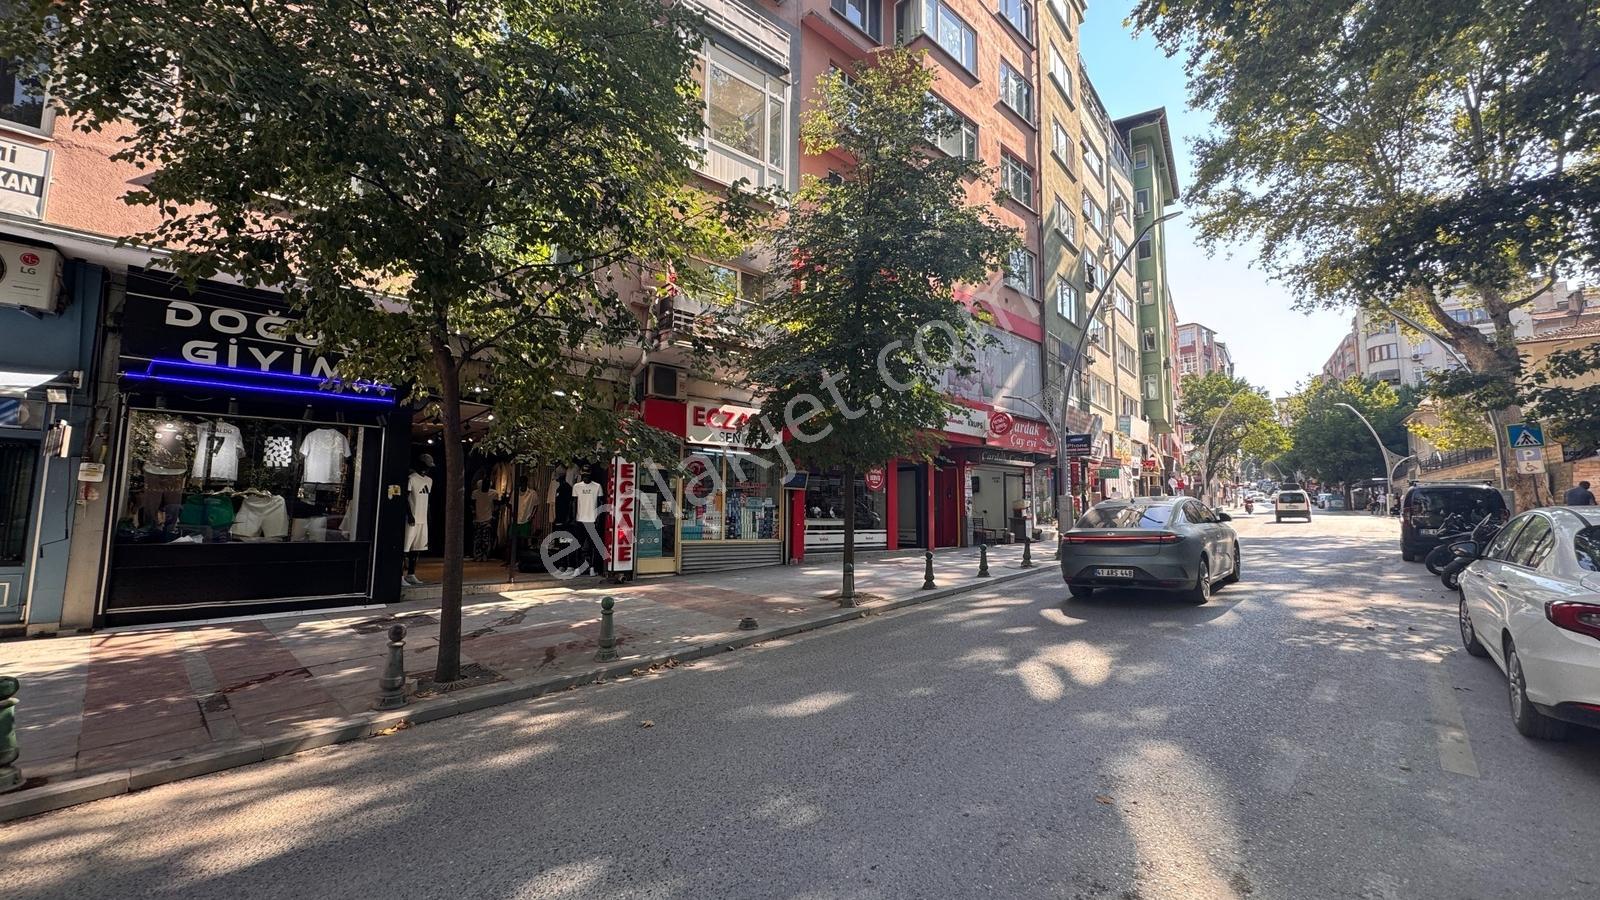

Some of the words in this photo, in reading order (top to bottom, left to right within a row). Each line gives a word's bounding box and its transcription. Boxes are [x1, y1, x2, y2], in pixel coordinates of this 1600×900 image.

[20, 266, 36, 275] LG
[1009, 420, 1041, 437] ardak
[1010, 433, 1026, 448] Çay
[1026, 439, 1038, 448] evi
